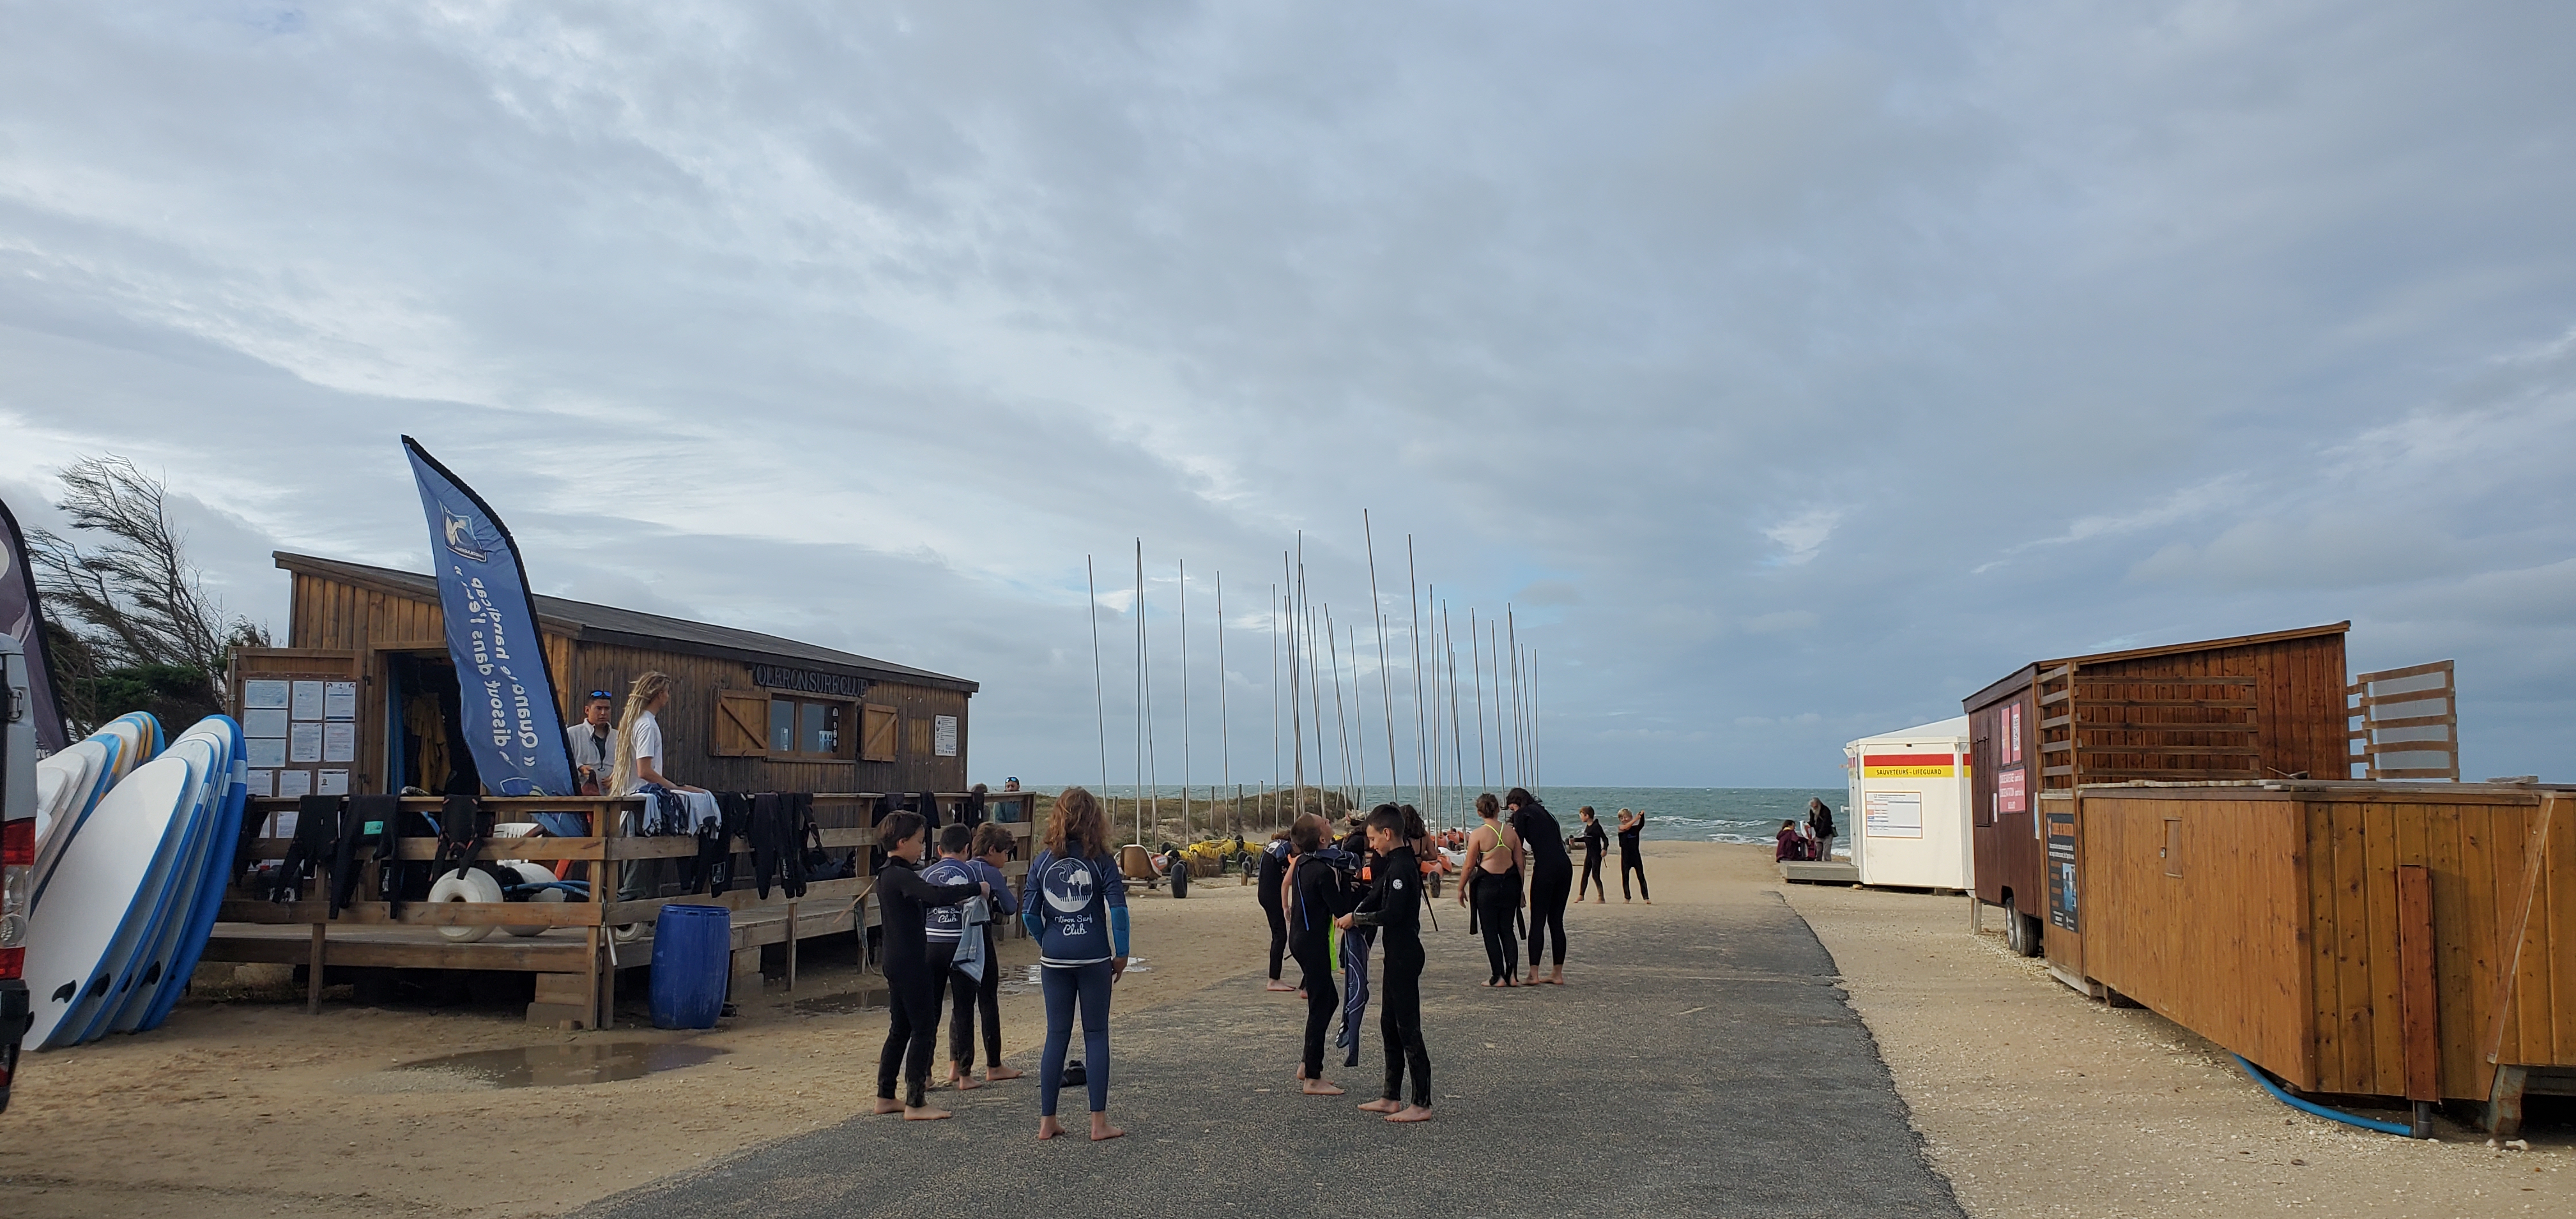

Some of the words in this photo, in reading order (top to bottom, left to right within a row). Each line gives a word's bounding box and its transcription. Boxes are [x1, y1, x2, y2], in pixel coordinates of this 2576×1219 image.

[756, 664, 808, 691] OLERON
[808, 672, 839, 693] SURF
[938, 914, 958, 923] Club
[1077, 913, 1093, 924] Surf
[1063, 923, 1087, 936] Club
